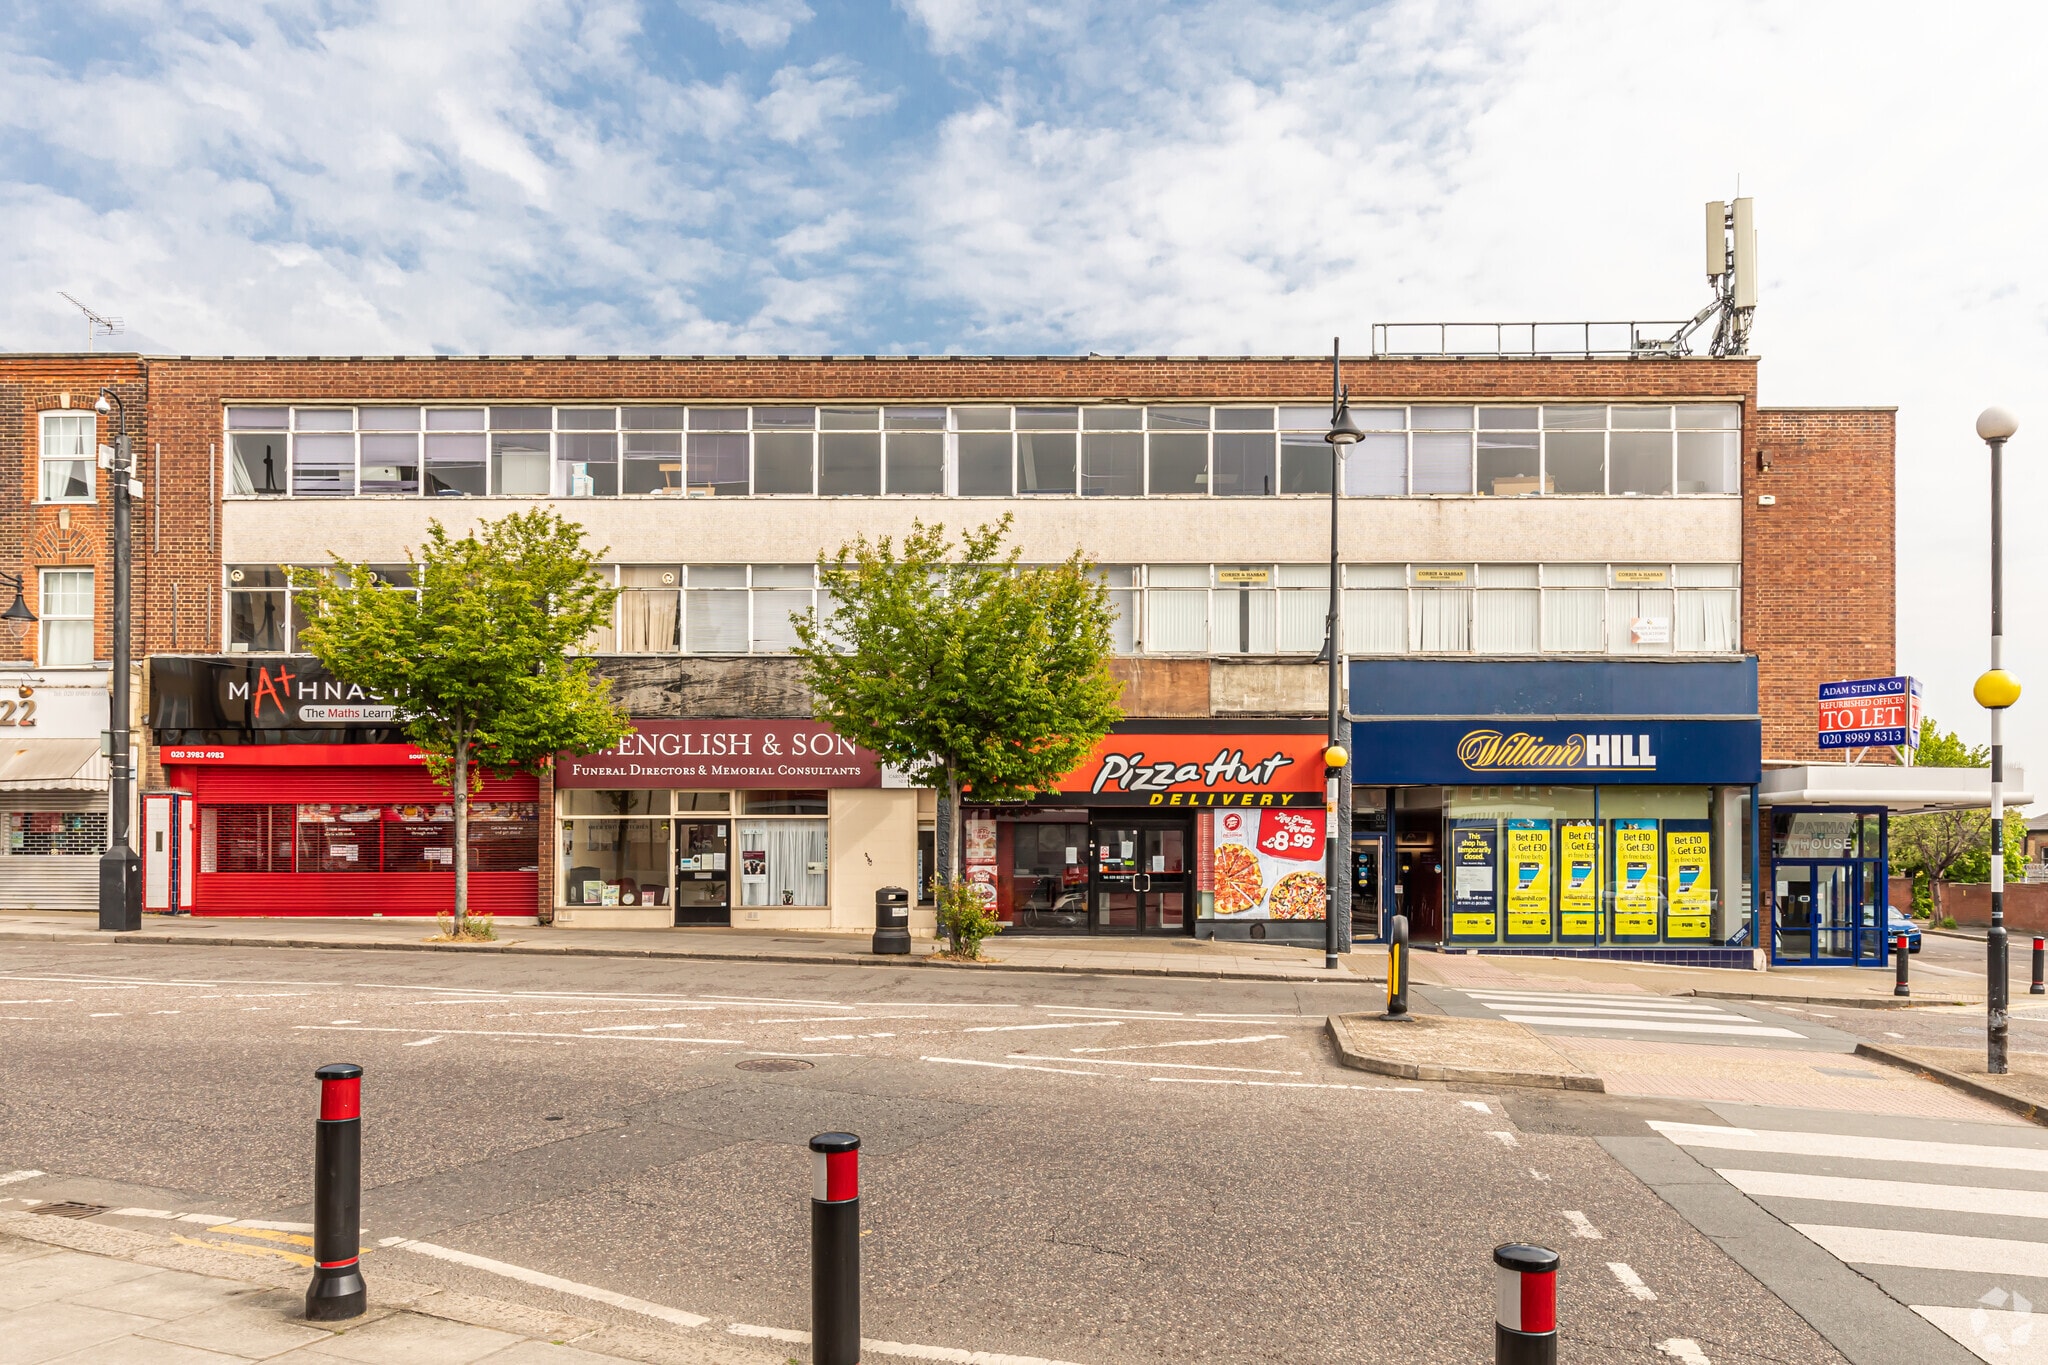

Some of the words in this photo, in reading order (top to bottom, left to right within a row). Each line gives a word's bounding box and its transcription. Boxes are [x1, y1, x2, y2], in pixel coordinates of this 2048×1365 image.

[1822, 686, 1849, 696] ADAM
[1851, 684, 1876, 694] STEIN
[1878, 682, 1886, 692] &
[1820, 699, 1872, 710] REFURBISHED
[1873, 696, 1905, 706] OFFICES
[305, 708, 325, 718] The
[327, 708, 360, 718] Maths
[1823, 709, 1854, 729] TO
[1860, 706, 1902, 727] LET
[1822, 733, 1842, 744] 020
[1844, 731, 1871, 743] 8989
[1874, 730, 1902, 742] 8313
[762, 733, 783, 756] &
[791, 733, 858, 756] SON
[1457, 729, 1587, 771] William
[1586, 734, 1657, 766] HILL
[698, 764, 707, 776] &
[1091, 752, 1201, 796] Pizza
[1203, 748, 1295, 787] Hut
[1149, 793, 1295, 806] DELIVERY
[1794, 821, 1857, 835] PATMAN
[1515, 833, 1529, 842] Bet
[1530, 833, 1543, 842] £10
[1568, 832, 1581, 840] Bet
[1583, 832, 1596, 840] £10
[1623, 833, 1637, 841] Bet
[1638, 833, 1651, 841] £10
[1674, 836, 1687, 844] Bet
[1689, 835, 1702, 844] £10
[1457, 846, 1491, 854] temporarily
[1518, 843, 1531, 852] Get
[1533, 843, 1547, 852] £30
[1571, 842, 1584, 850] Get
[1626, 843, 1639, 851] Get
[1641, 843, 1655, 851] £30
[1799, 838, 1853, 850] HOUSE
[1677, 846, 1691, 855] Get
[1693, 846, 1707, 854] £30
